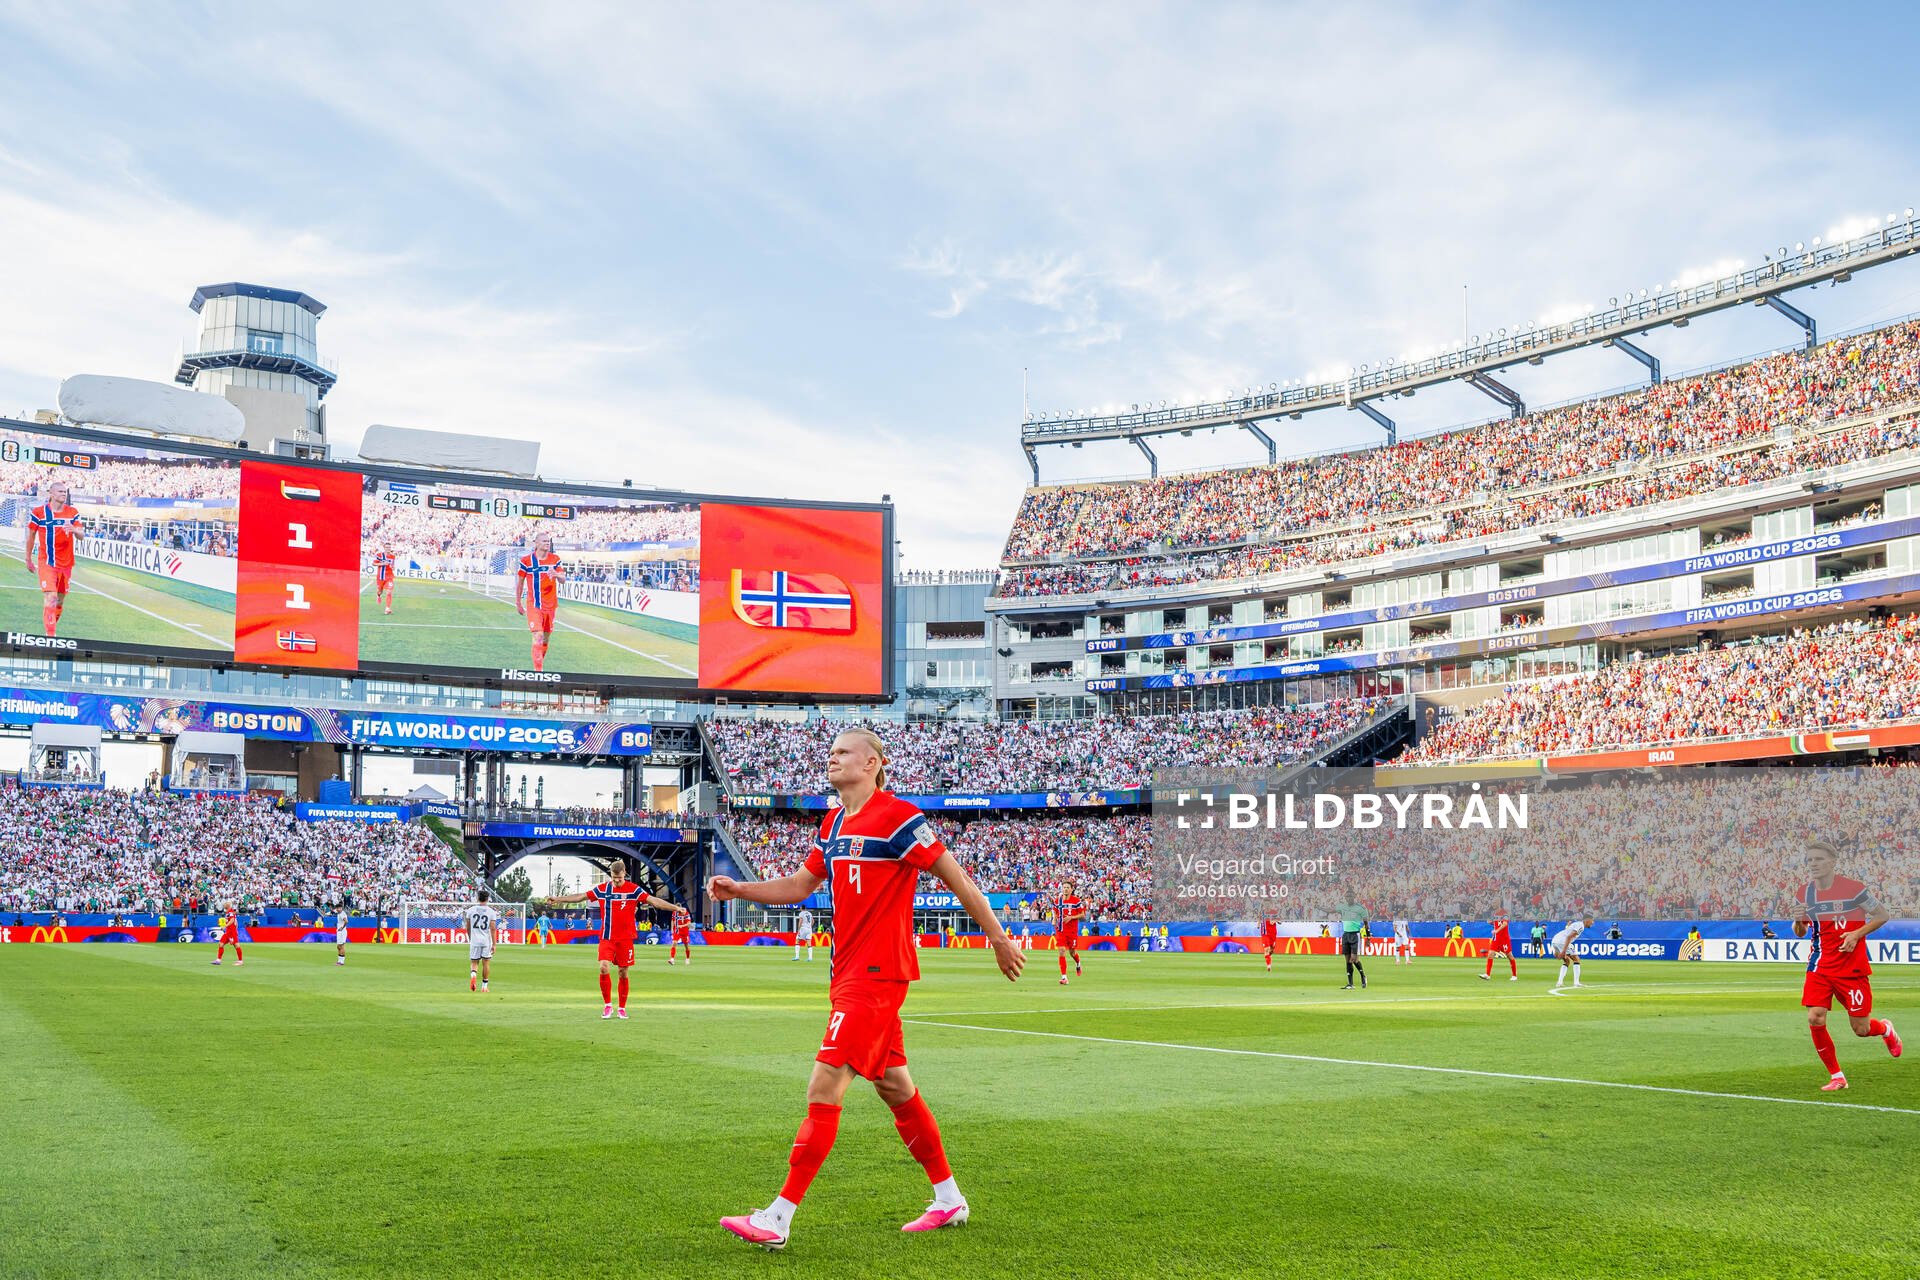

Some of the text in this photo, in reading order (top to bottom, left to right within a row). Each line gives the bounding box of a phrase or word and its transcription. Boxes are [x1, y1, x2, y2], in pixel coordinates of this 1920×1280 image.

[24, 449, 30, 460] 1
[40, 450, 60, 463] NOR
[384, 492, 419, 506] 42:26
[461, 499, 476, 510] IRQ
[484, 502, 490, 512] 1
[512, 504, 518, 514] 1
[526, 505, 544, 516] NOR
[288, 523, 312, 549] 1
[75, 539, 161, 573] ANK OF AMERICA
[1685, 534, 1842, 572] FIFA WORLD CUP 2026
[397, 568, 445, 580] MERICA
[286, 584, 311, 610] 1
[558, 583, 633, 610] ANK OF AMERICA
[1488, 586, 1537, 603] BOSTON
[1686, 589, 1843, 623] FIFA WORLD CUP 2026
[7, 632, 77, 649] Hisense
[1488, 634, 1537, 650] BOSTON
[501, 669, 561, 683] Hisense
[213, 711, 302, 733] BOSTON
[352, 719, 575, 744] FIFA WORLD CUP 2026
[621, 732, 652, 747] BO
[1648, 751, 1674, 763] IRAQ
[308, 809, 325, 817] FIFA
[326, 810, 353, 818] WORLD
[355, 811, 370, 819] CUP
[427, 805, 458, 816] BOSTON
[534, 827, 634, 838] FIFA WORLD CUP 2026
[849, 864, 861, 894] 9
[926, 896, 950, 907] CUP
[472, 914, 488, 930] 23
[1832, 915, 1847, 930] 10
[420, 928, 446, 944] i'm
[498, 929, 511, 944] it
[1361, 937, 1396, 956] lovin
[1521, 942, 1546, 955] FIA
[1547, 943, 1589, 955] WLD
[1591, 943, 1615, 956] CUP
[1617, 943, 1661, 956] 2026
[1726, 941, 1800, 960] BANK
[1848, 989, 1864, 1006] 10
[830, 1011, 845, 1041] 9
